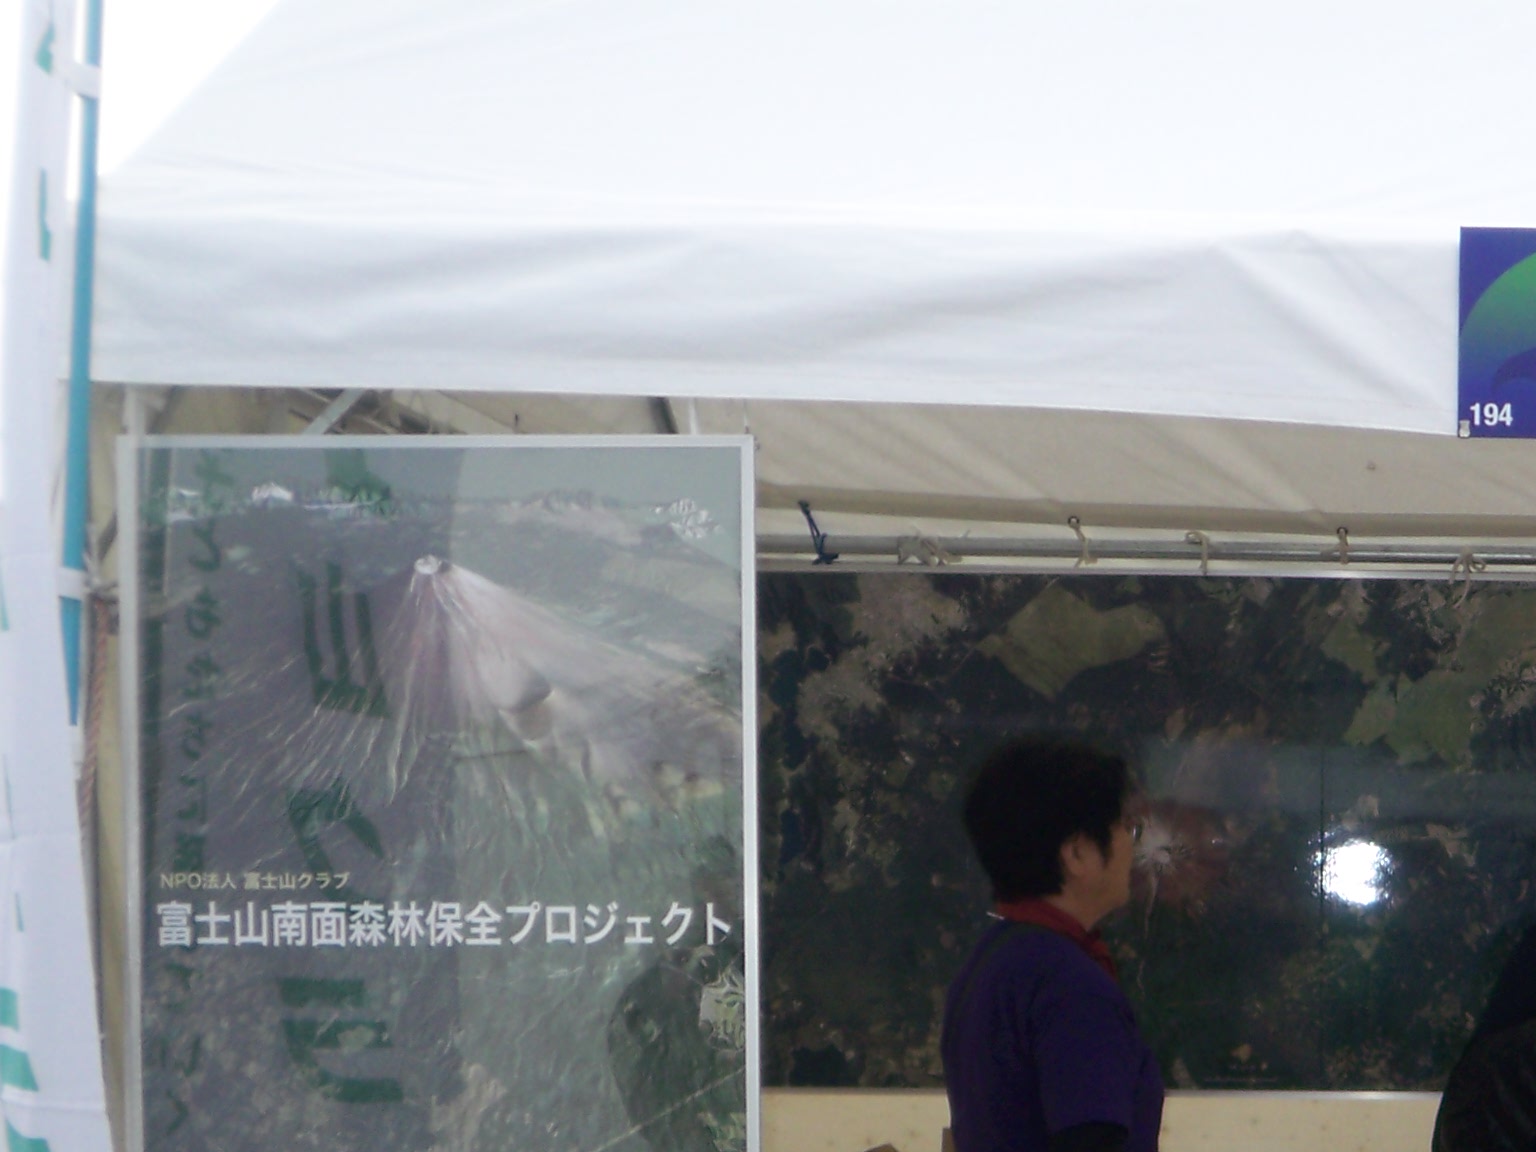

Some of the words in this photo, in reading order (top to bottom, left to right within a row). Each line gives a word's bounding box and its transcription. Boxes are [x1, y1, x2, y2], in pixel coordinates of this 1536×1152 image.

[1469, 402, 1514, 426] 194
[160, 873, 236, 889] NPO法人
[244, 872, 350, 890] 富士山クラブ
[156, 900, 732, 947] 富士山南面森林保全プロジェクト
